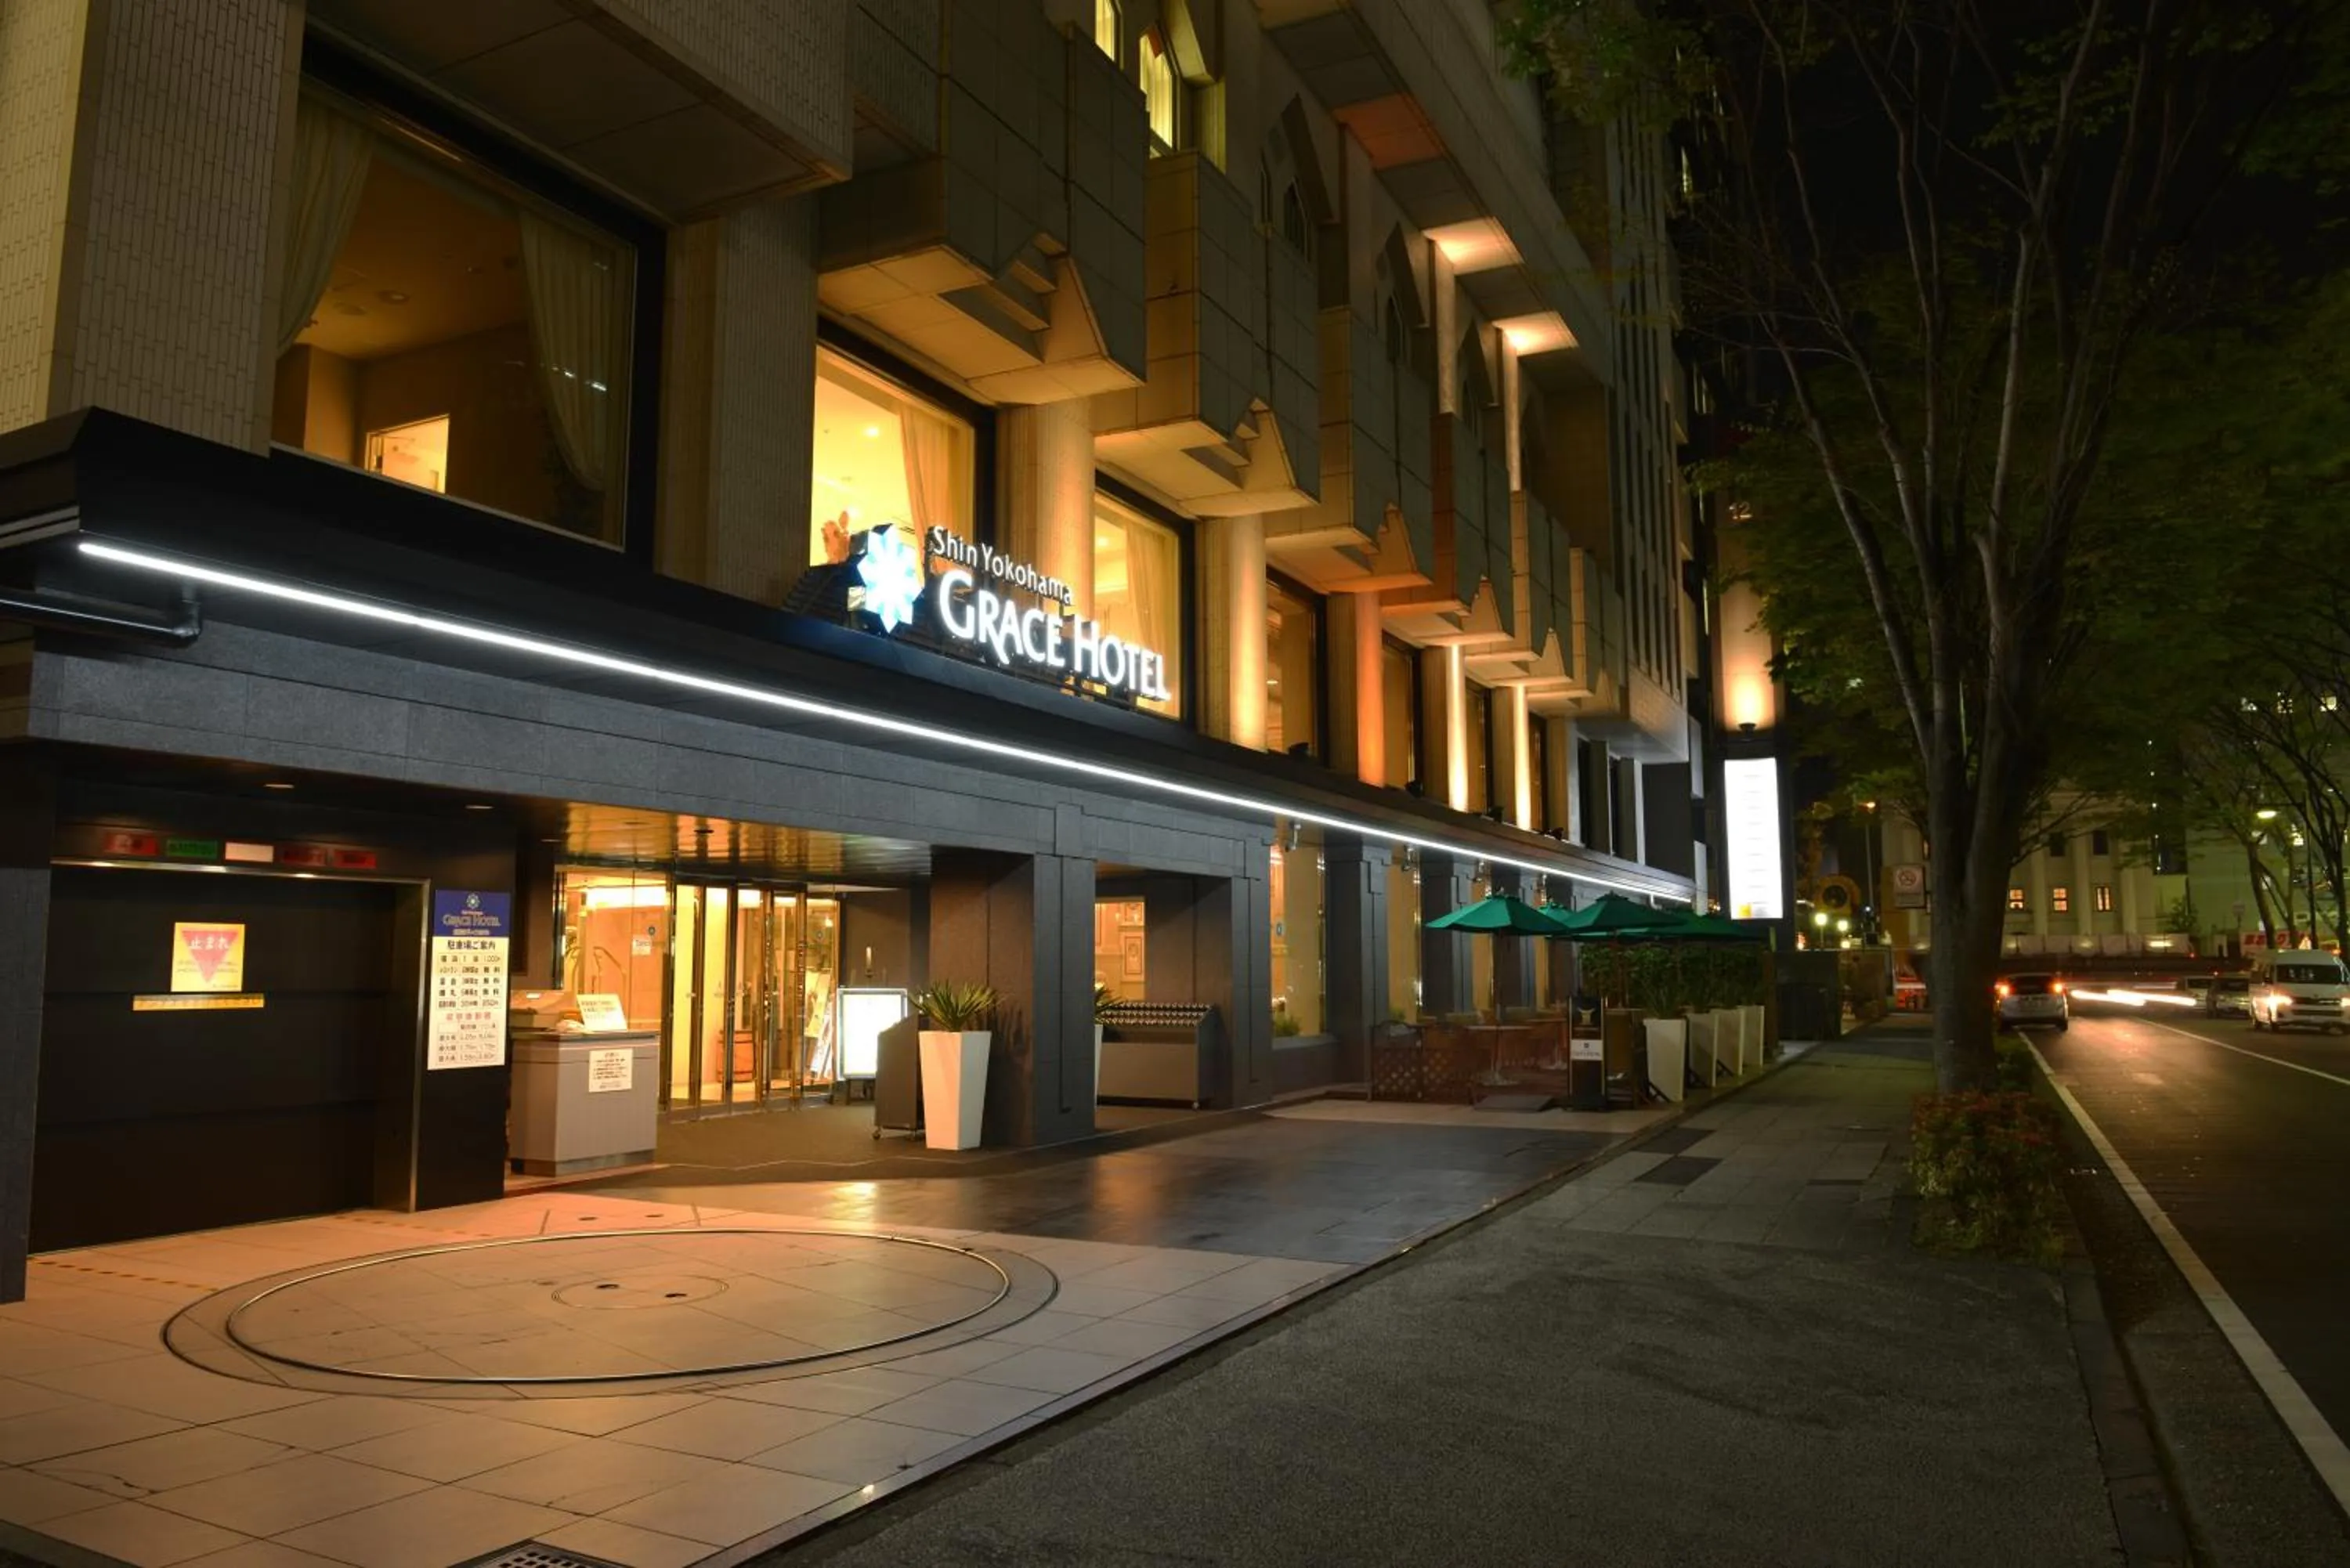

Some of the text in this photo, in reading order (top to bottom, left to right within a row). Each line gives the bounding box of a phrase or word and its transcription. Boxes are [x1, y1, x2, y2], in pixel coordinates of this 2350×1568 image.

[933, 526, 1072, 605] Shin Yokohama
[939, 569, 1172, 701] GRACE HOTEL
[189, 935, 230, 950] 止まれ
